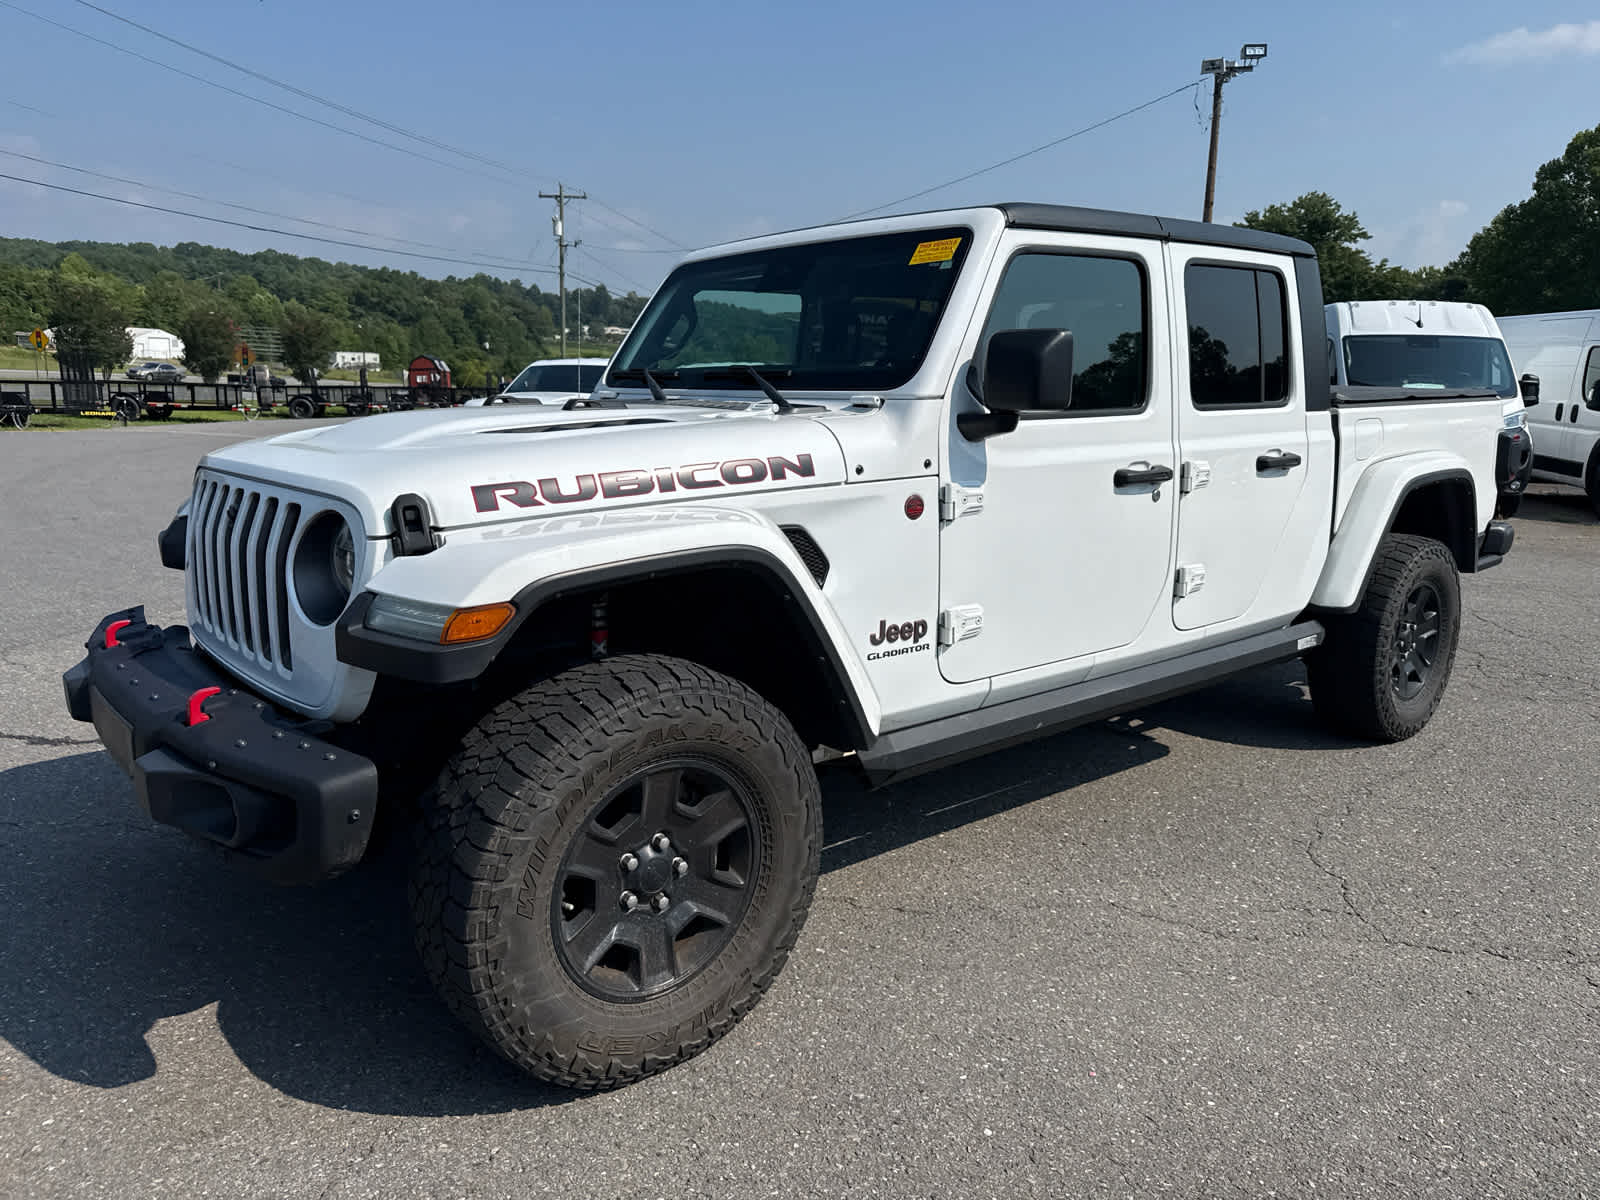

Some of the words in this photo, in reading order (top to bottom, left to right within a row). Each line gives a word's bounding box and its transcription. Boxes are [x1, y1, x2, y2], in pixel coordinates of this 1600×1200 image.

[470, 453, 816, 513] RUBICON
[866, 643, 931, 661] GLADIATOR
[869, 618, 928, 646] Jeep
[515, 721, 689, 920] WILDPEAK
